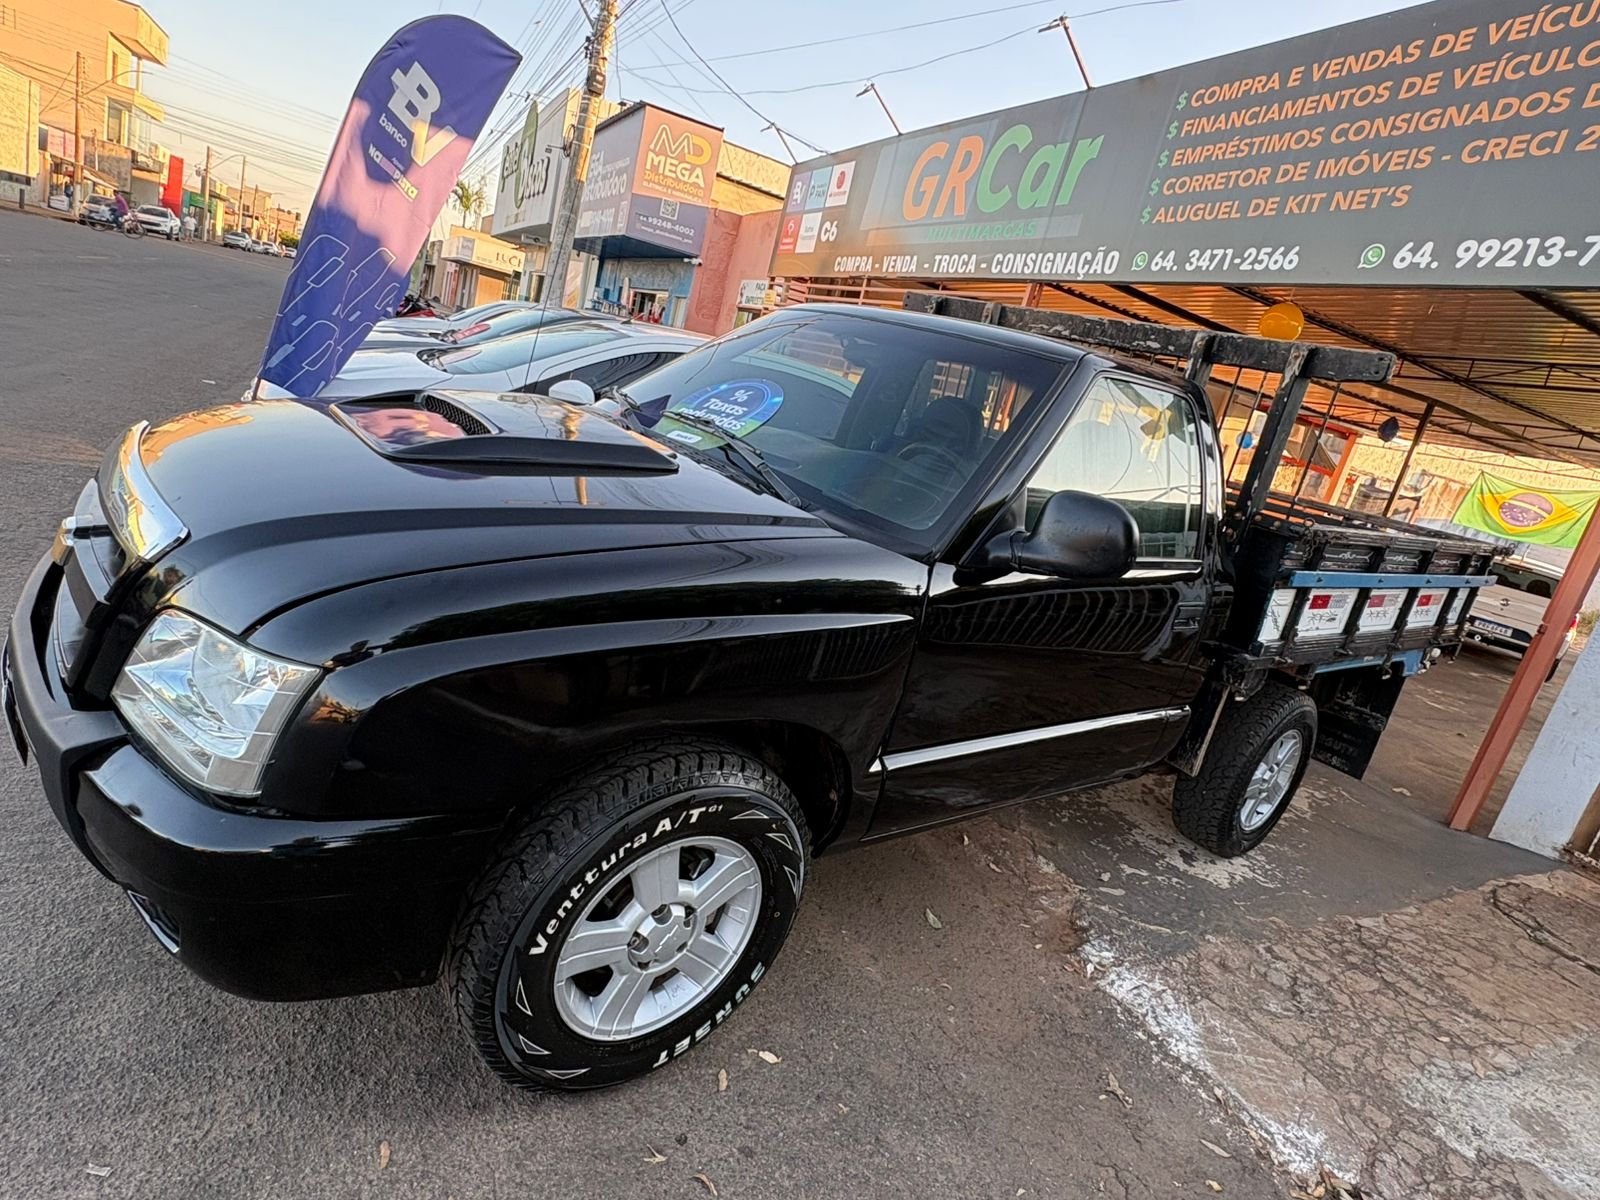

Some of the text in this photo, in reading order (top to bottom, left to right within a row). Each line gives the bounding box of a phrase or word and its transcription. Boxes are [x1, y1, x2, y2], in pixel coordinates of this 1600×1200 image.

[1191, 72, 1280, 107] COMPRA
[1287, 66, 1305, 88] E
[1312, 39, 1425, 82] VENDAS
[1429, 27, 1478, 58] DE
[1488, 0, 1600, 46] VEÍCU
[1180, 81, 1394, 137] FINANCIAMENTOS
[1398, 71, 1444, 100] DE
[378, 113, 408, 148] banco
[1171, 126, 1325, 166] EMPRÉSTIMOS
[1331, 87, 1576, 144] CONSIGNADOS
[645, 150, 705, 188] MEGA
[1162, 166, 1271, 195] CORRETOR
[1275, 161, 1310, 184] DE
[1314, 145, 1436, 179] IMÓVEIS
[1460, 129, 1569, 164] CRECI
[1152, 200, 1241, 224] ALUGUEL
[1247, 197, 1280, 217] DE
[1284, 193, 1326, 215] KIT
[1329, 184, 1413, 211] NET'S
[821, 220, 838, 242] C6
[927, 221, 1038, 241] MULTIMARCAS
[833, 255, 873, 273] COMPRA
[882, 254, 918, 273] VENDA
[933, 254, 976, 273] TROCA
[991, 246, 1120, 280] CONSIGNAÇÃO
[1150, 246, 1300, 272] 64. 3471-2566
[1392, 241, 1439, 269] 64.
[703, 398, 748, 416] Taxas
[653, 961, 766, 1069] SUNSET
